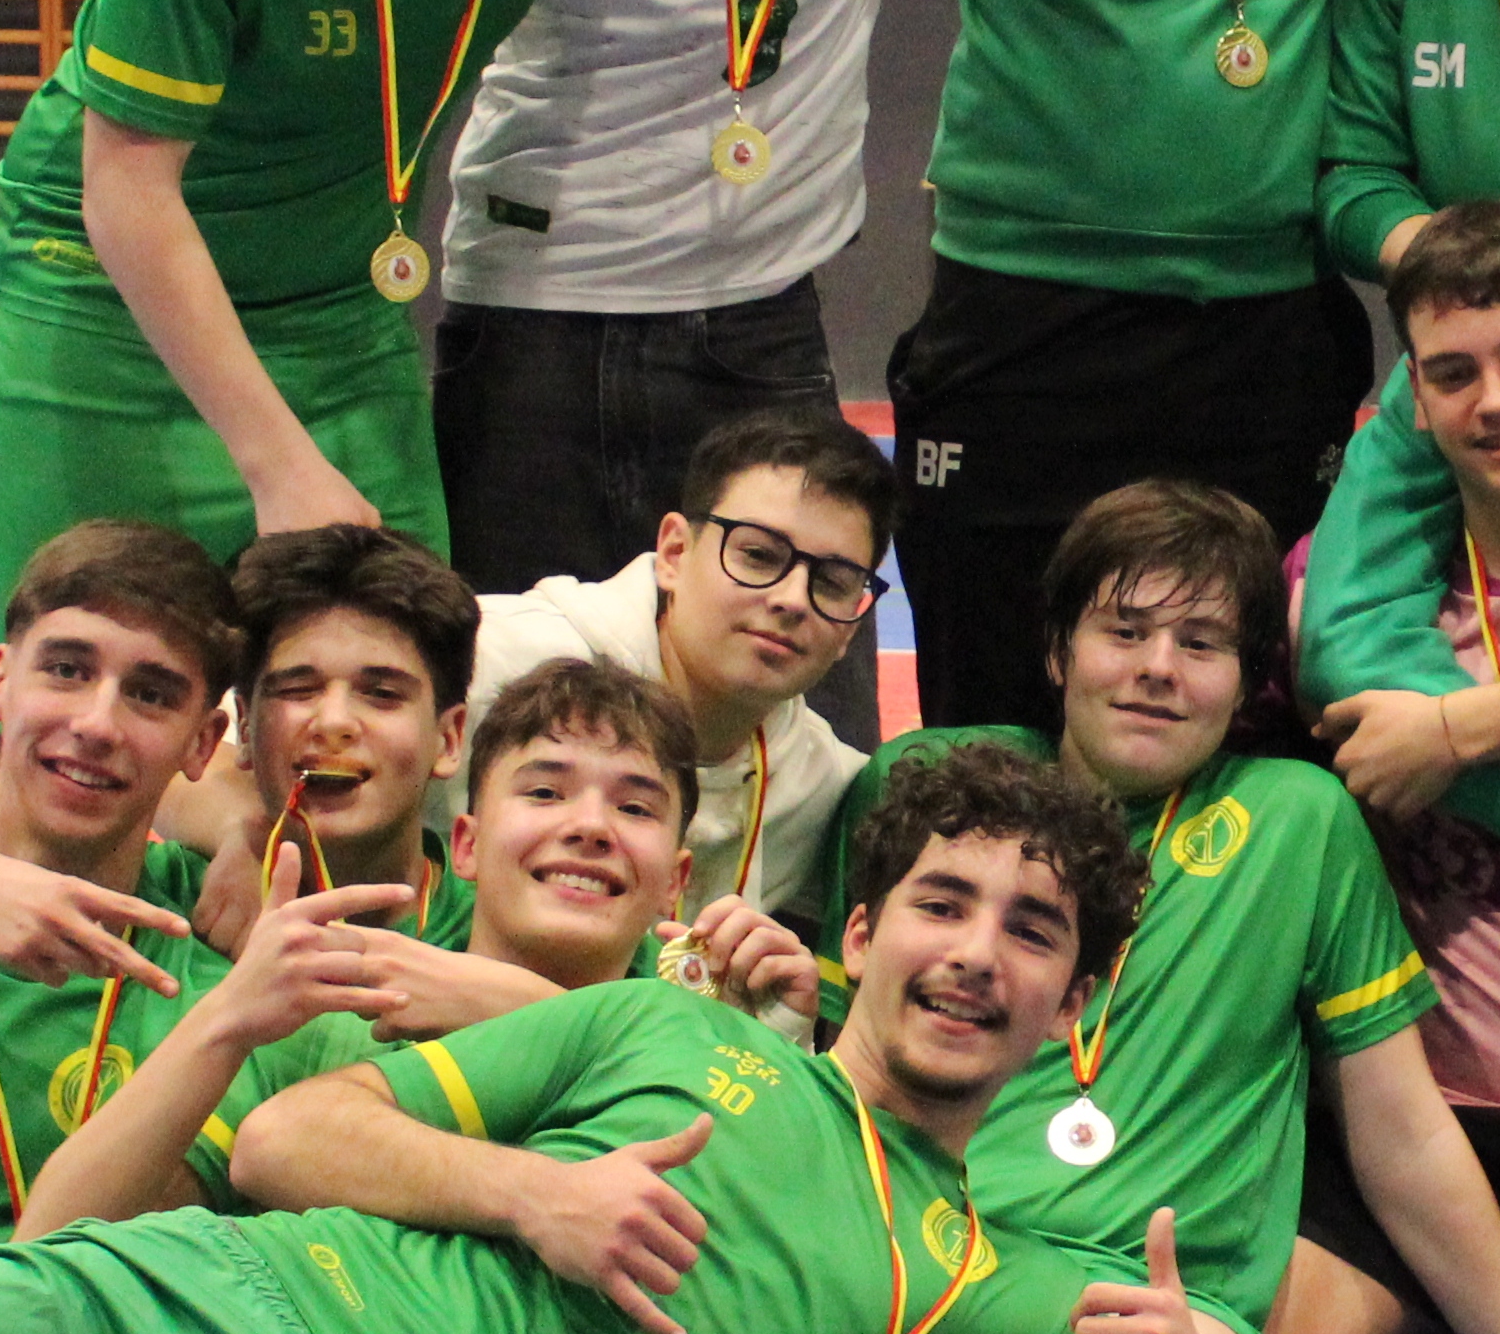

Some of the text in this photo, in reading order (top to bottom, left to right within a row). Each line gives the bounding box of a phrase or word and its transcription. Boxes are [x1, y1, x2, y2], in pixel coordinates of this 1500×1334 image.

[304, 9, 357, 57] 33
[1412, 42, 1466, 88] SM
[916, 438, 964, 488] BF
[706, 1066, 756, 1116] 30
